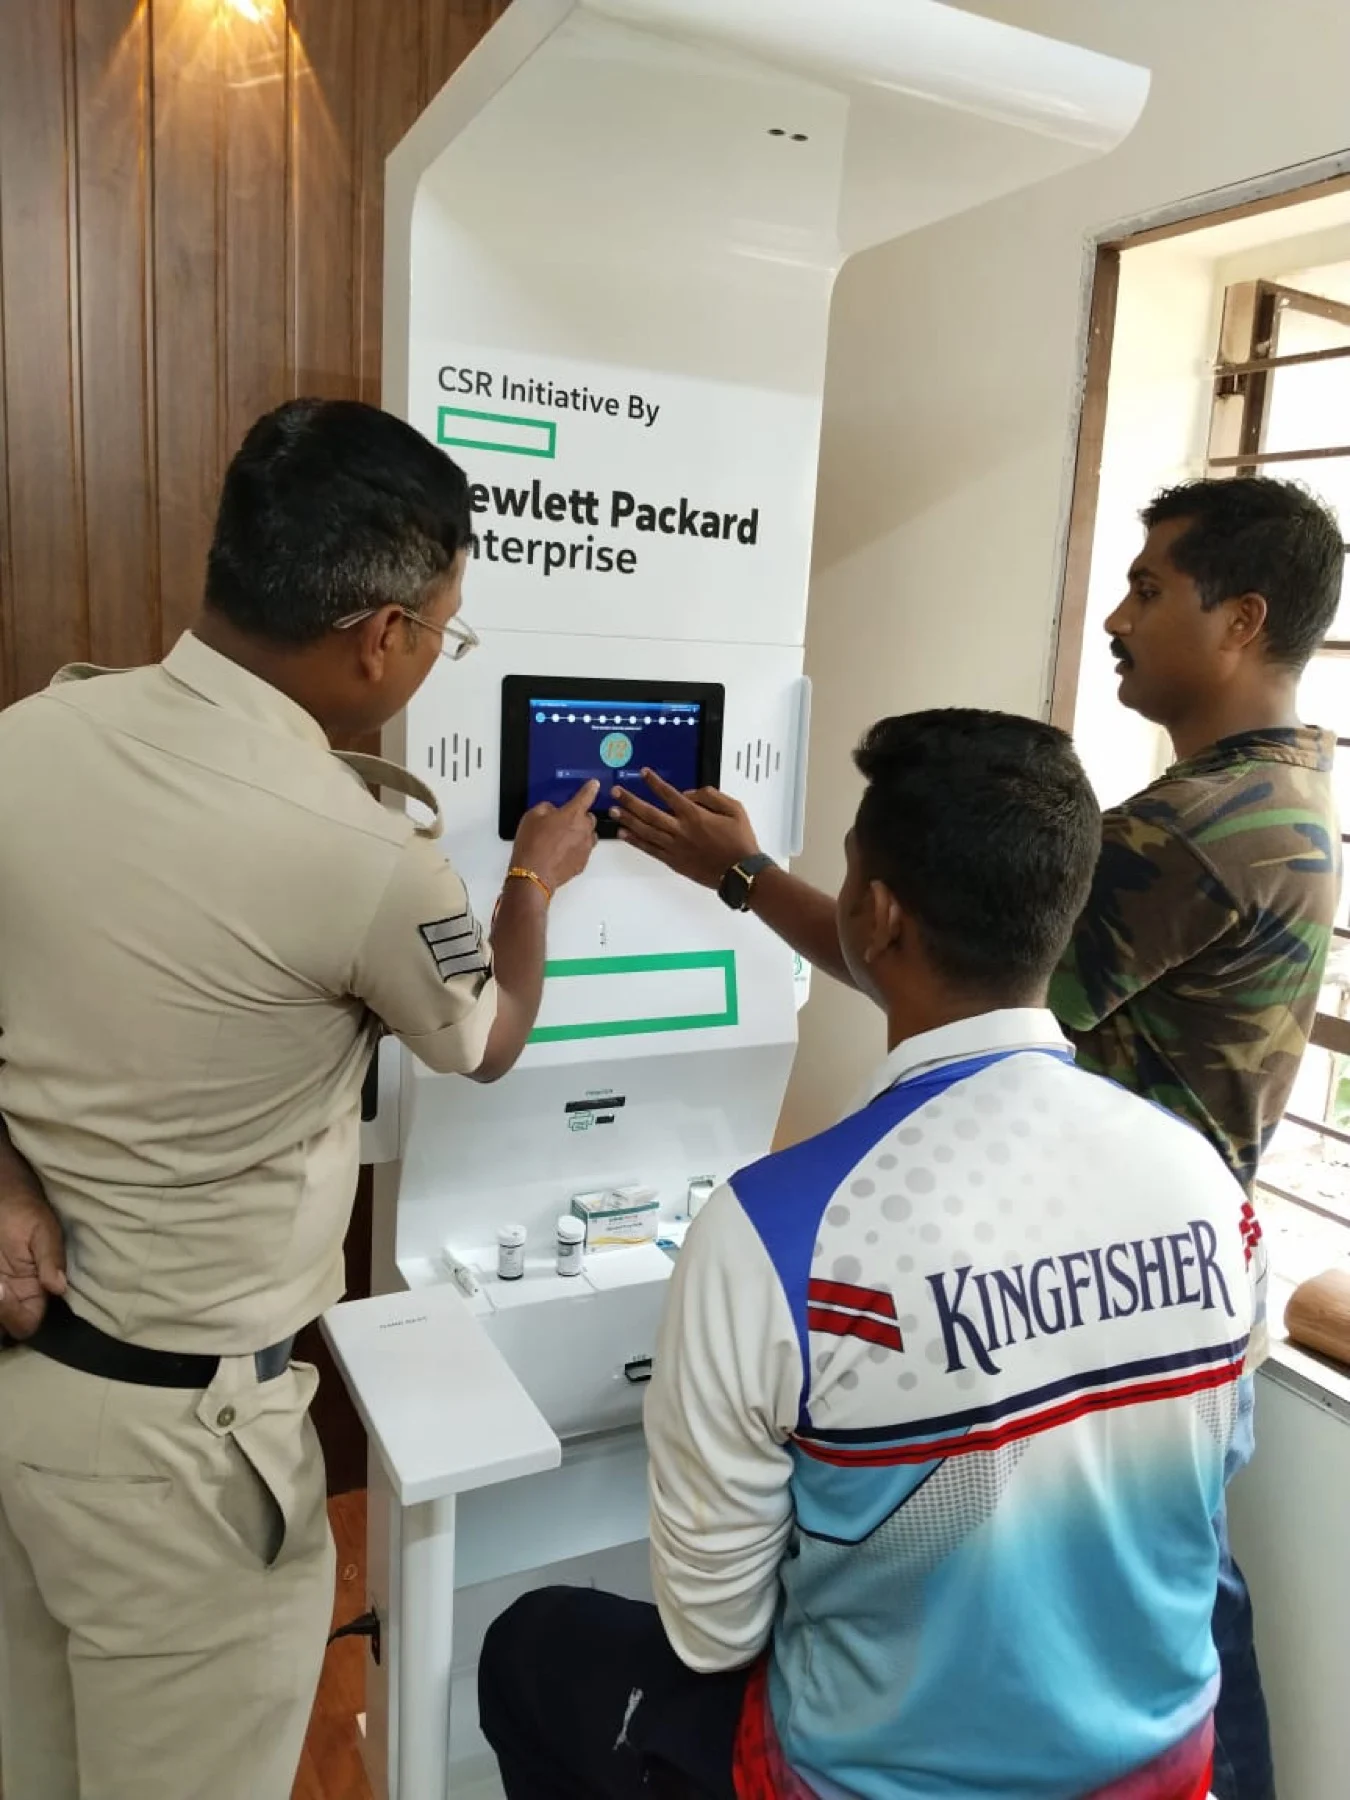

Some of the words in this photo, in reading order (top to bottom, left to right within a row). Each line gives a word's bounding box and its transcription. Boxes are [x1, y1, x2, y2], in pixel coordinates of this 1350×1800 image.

[438, 365, 493, 398] CSR
[502, 374, 620, 417] Initiative
[627, 394, 661, 428] By
[469, 479, 600, 527] ewlett
[610, 490, 759, 545] Packard
[470, 528, 638, 577] nterprise
[924, 1219, 1236, 1376] KINGFISHER
